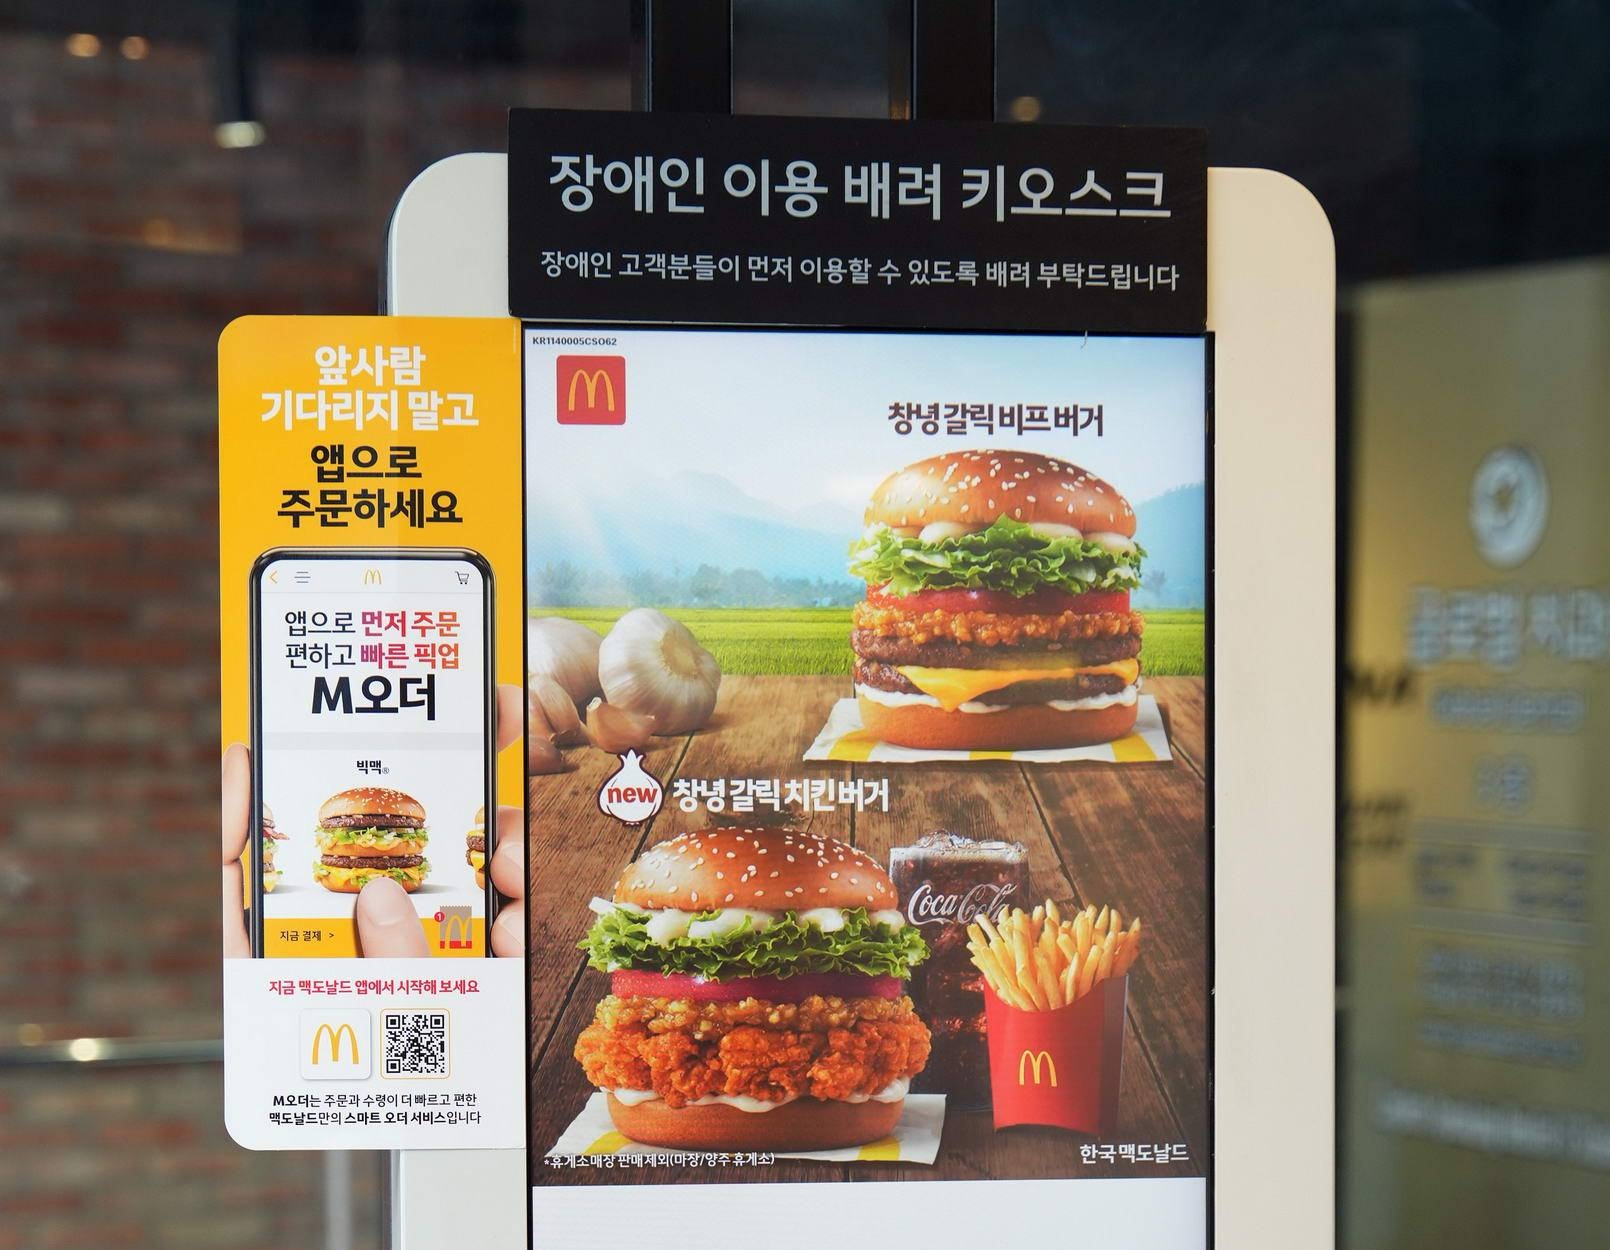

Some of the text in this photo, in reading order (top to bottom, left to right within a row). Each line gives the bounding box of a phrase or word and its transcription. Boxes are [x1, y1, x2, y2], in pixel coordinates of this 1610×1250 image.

[550, 154, 1171, 222] 장애인 이용 배려 키오스크
[541, 251, 1179, 291] 장애인 고객분들이 먼저 이용할 수 있도록 배려 부탁드립니다
[315, 344, 426, 386] 앞사람
[262, 389, 479, 431] 기다리지 말고
[888, 402, 1103, 437] 창녕 갈릭 비프 버거
[310, 444, 422, 483] 앱으로
[278, 488, 463, 528] 주문하세요
[285, 611, 460, 637] 앱으로 먼저 주문
[286, 643, 459, 669] 편하고 빠른 픽업
[312, 674, 435, 721] M오더
[606, 783, 658, 806] new
[671, 776, 888, 812] 창녕 갈릭 치킨 버거
[280, 930, 322, 941] 지금 결제
[269, 980, 479, 995] 지금 맥도날드 앱에서 시작해 보세요
[273, 1094, 477, 1107] M오더는 주문과 수령이 더 빠르고 편한
[270, 1111, 481, 1125] 맥도날드만의 스마트 오더 서비스입니다
[732, 1152, 775, 1166] 휴게소)
[1080, 1143, 1189, 1164] 한국 맥도날드
